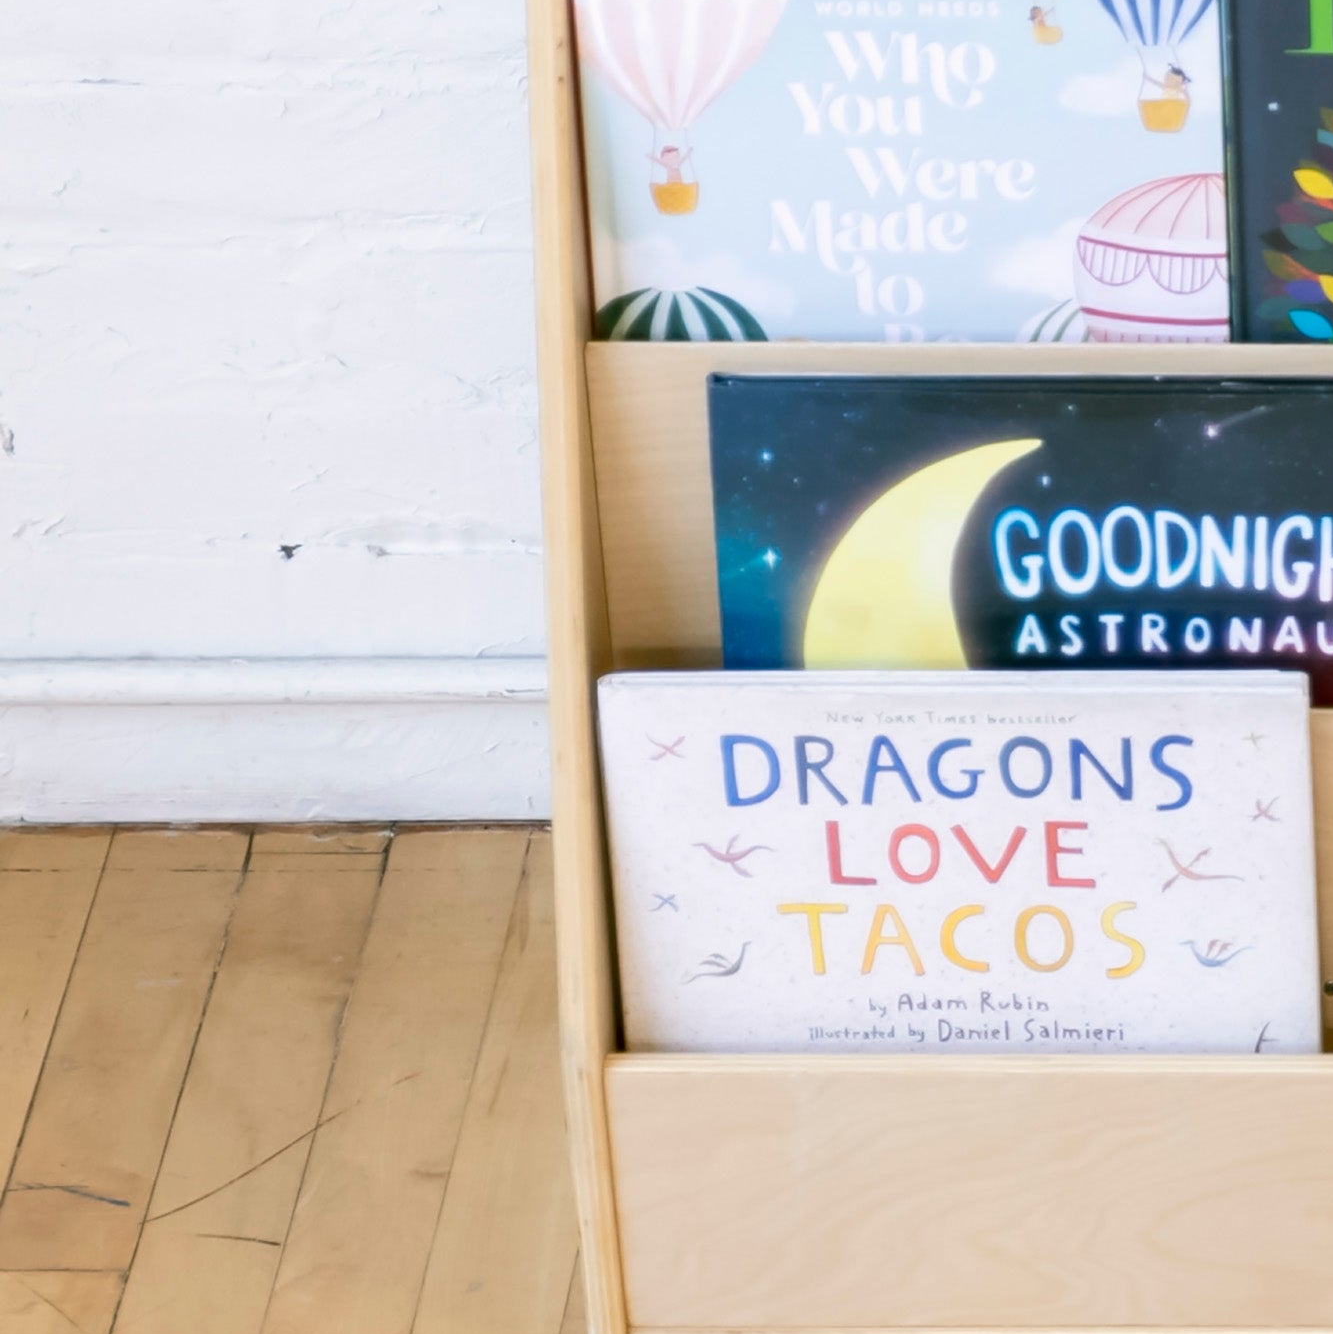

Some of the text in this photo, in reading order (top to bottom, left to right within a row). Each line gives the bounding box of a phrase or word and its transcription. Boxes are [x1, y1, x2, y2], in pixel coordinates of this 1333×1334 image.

[814, 0, 1001, 18] WORLD NEEDS
[824, 31, 996, 108] Who
[787, 83, 923, 136] You
[845, 147, 1037, 201] Were
[768, 200, 968, 275] Made
[827, 712, 864, 723] New
[875, 712, 917, 724] York
[719, 734, 1195, 812] DRAGONS
[825, 820, 1096, 889] LOVE
[777, 901, 1146, 980] TACOS
[868, 991, 1050, 1017] by Adam Rubin
[908, 1024, 925, 1042] by
[938, 1019, 1010, 1042] Daniel
[1023, 1018, 1125, 1042] Salmieri
